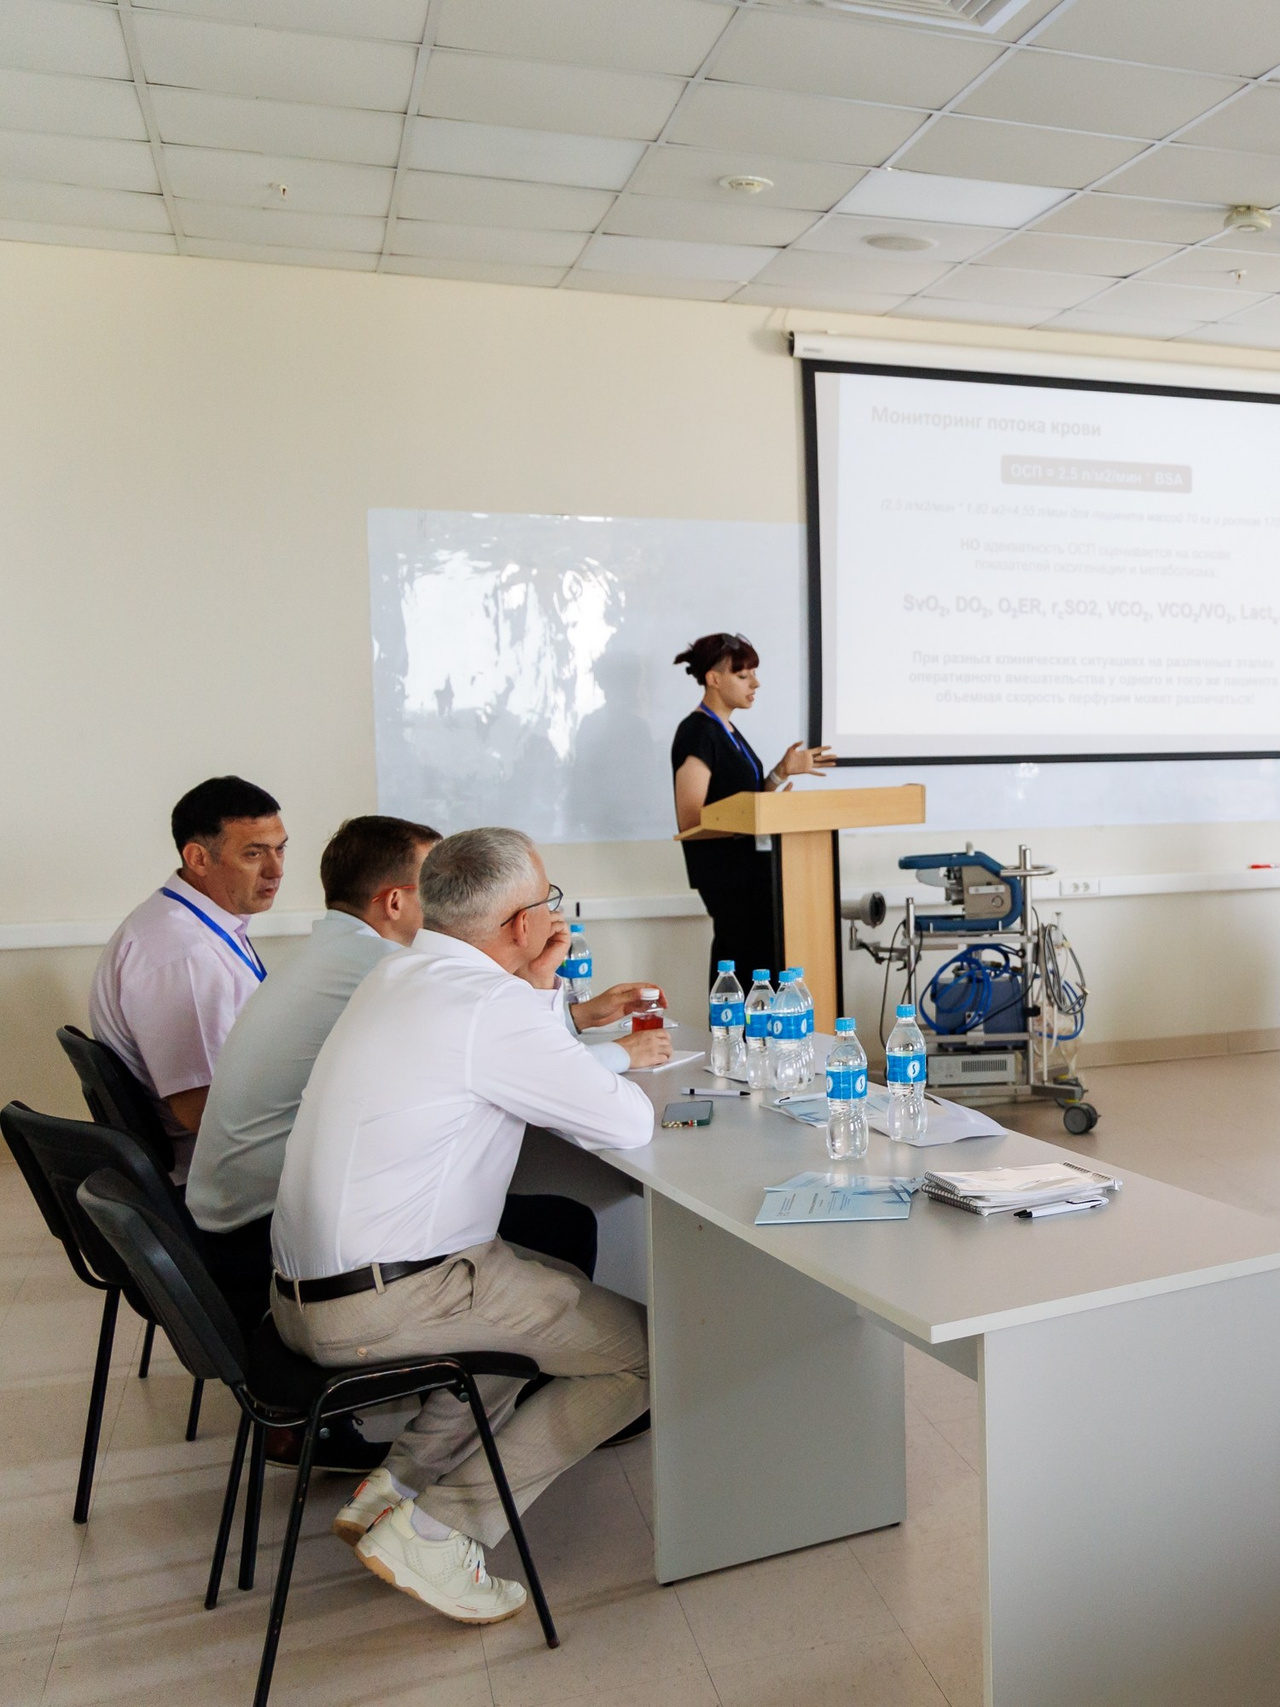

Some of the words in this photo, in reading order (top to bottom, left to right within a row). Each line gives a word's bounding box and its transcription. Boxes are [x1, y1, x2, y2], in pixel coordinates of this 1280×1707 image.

[871, 406, 983, 432] Мониторинг
[988, 412, 1046, 434] потока
[1051, 417, 1102, 438] крови
[1011, 464, 1042, 478] ОСП
[1058, 466, 1079, 482] 2,5
[1155, 472, 1183, 486] BSA
[1186, 513, 1198, 523] 70
[1264, 516, 1280, 527] 170
[960, 538, 980, 550] НО
[984, 541, 1064, 554] адекватность
[1068, 542, 1096, 554] ОСП
[1098, 546, 1172, 558] оценивается
[1176, 549, 1189, 558] на
[1192, 550, 1231, 560] основе
[974, 559, 1050, 572] показателей
[1053, 563, 1126, 575] оксигенации
[912, 650, 938, 665] При
[943, 654, 991, 666] разных
[996, 655, 1078, 666] клинических
[1080, 656, 1145, 669] ситуациях
[1149, 658, 1162, 667] на
[1166, 658, 1232, 670] различных
[1236, 658, 1275, 669] этапах
[909, 671, 1001, 685] оперативного
[1005, 673, 1105, 685] вмешательства
[1119, 676, 1162, 686] одного
[1177, 676, 1202, 686] того
[1205, 677, 1220, 686] же
[1224, 676, 1278, 687] пациента
[936, 689, 1002, 703] объемная
[1006, 692, 1064, 706] скорость
[1068, 692, 1130, 706] перфузии
[1134, 694, 1172, 704] может
[1176, 693, 1255, 707] различаться!
